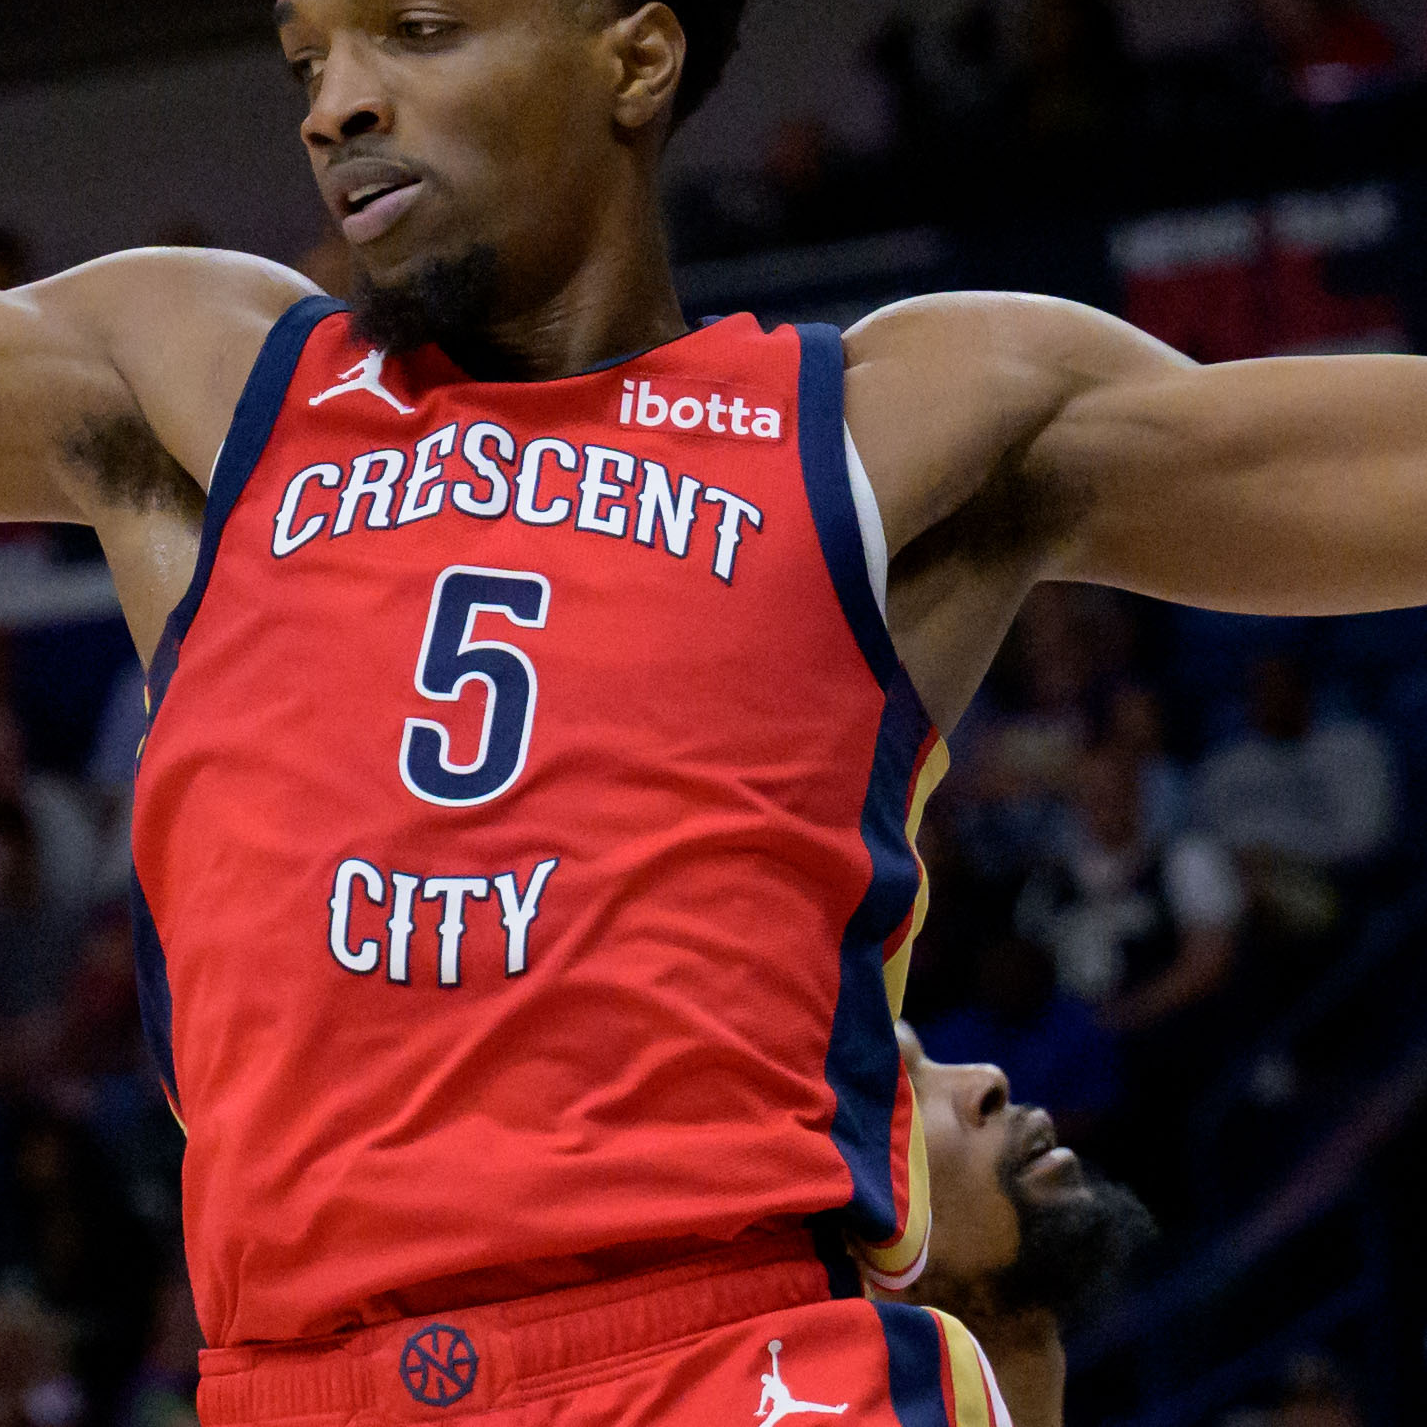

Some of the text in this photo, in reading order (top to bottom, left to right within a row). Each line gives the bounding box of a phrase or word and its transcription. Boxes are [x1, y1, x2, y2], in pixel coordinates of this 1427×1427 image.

[619, 379, 781, 438] ibotta
[272, 421, 764, 584] CRESCENT
[398, 564, 551, 807] 5
[327, 858, 560, 988] CITY
